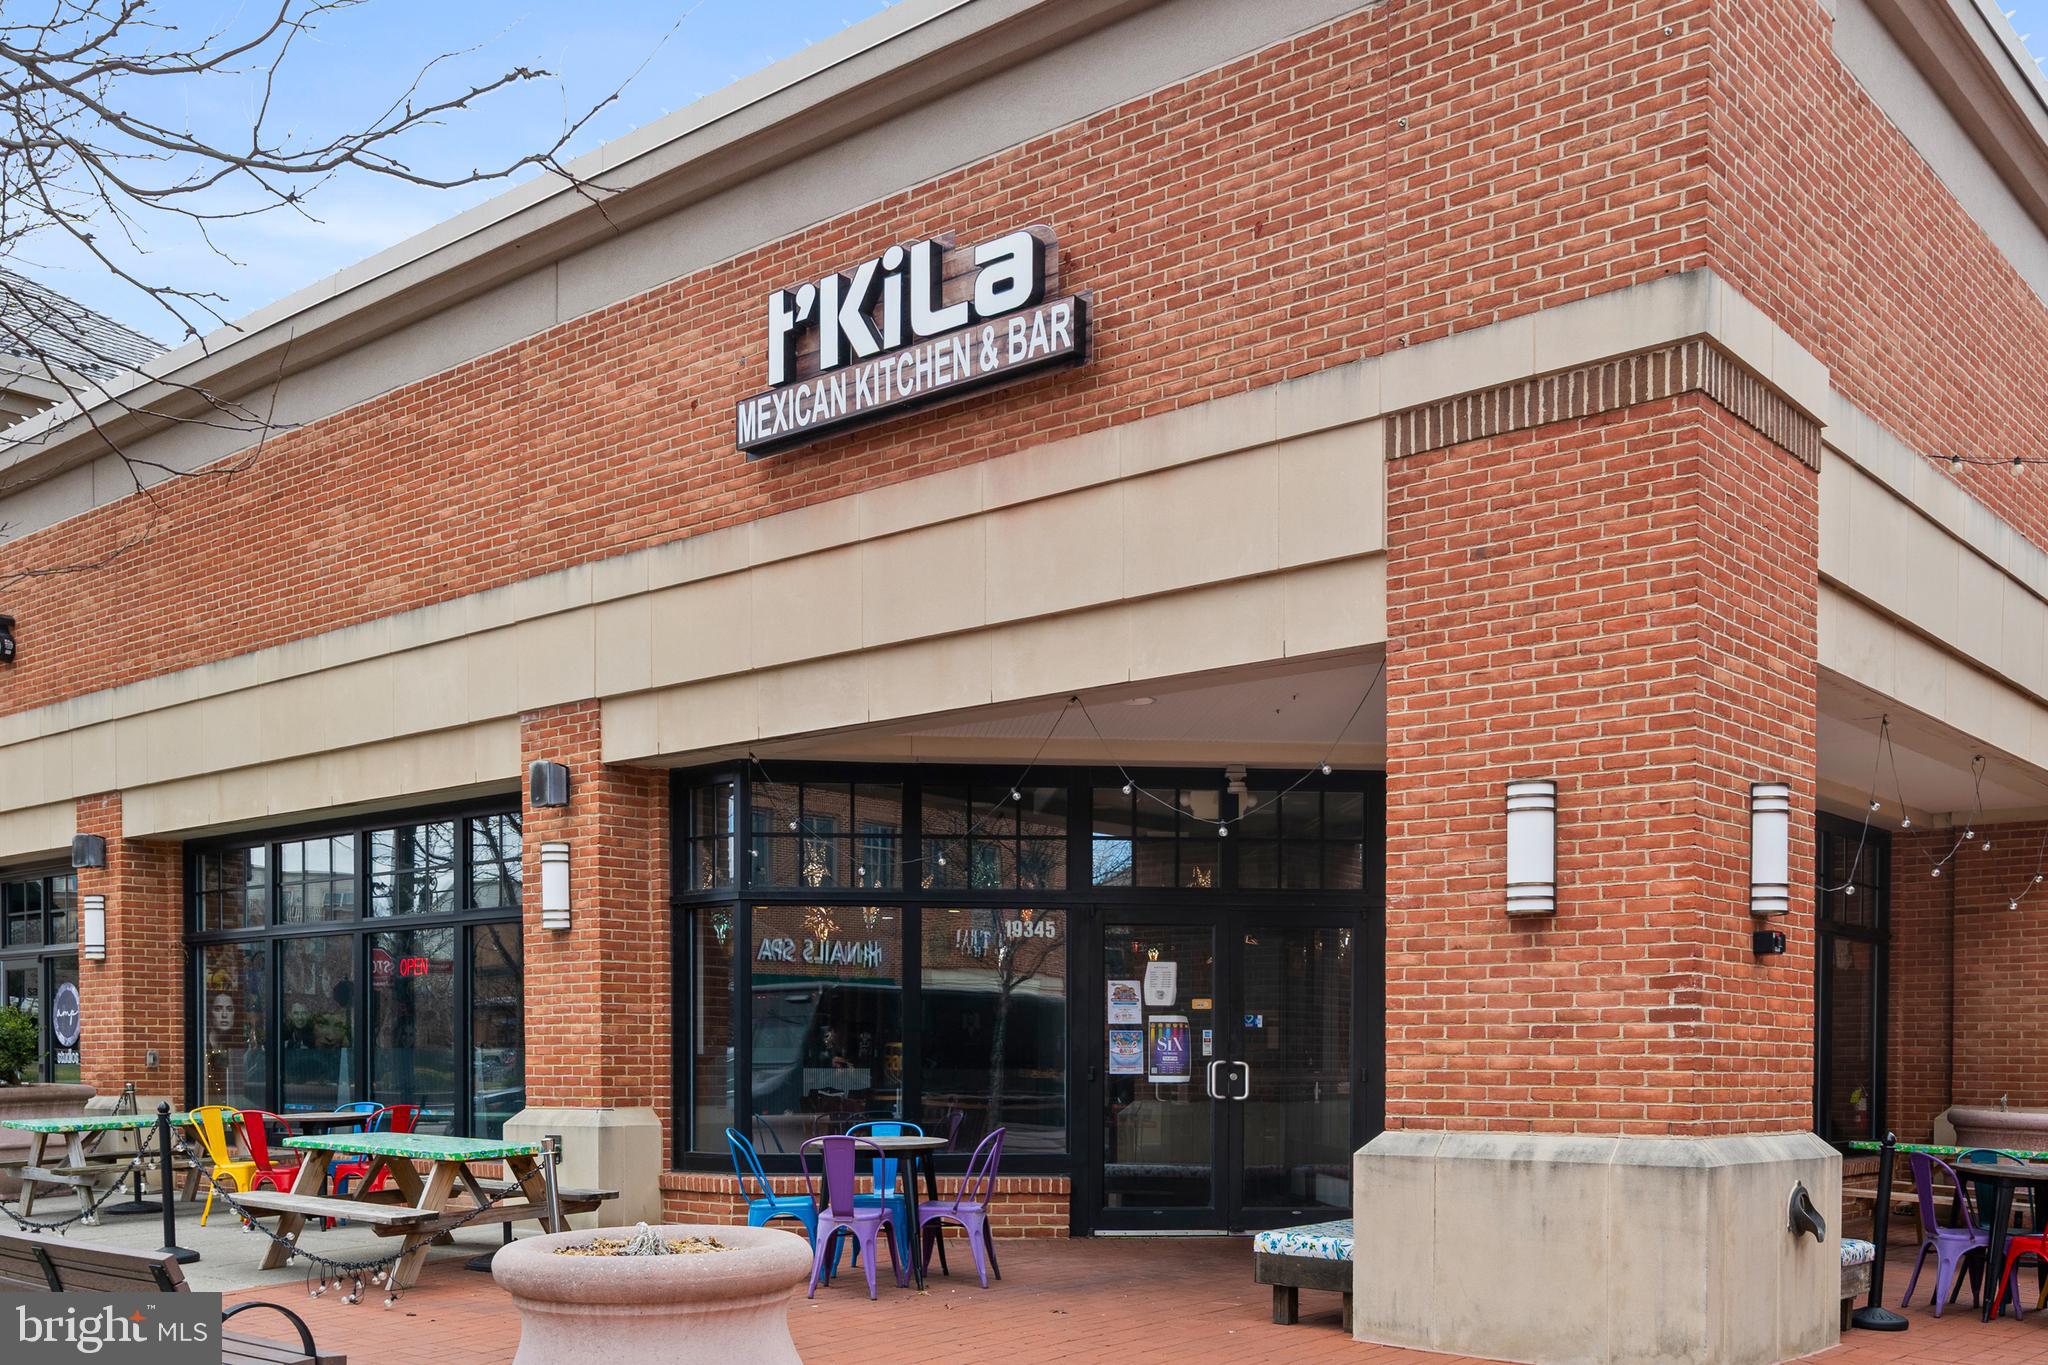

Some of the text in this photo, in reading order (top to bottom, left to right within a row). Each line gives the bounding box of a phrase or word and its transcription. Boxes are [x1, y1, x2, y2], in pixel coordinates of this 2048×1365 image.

[738, 303, 1072, 444] MEXICAN KITCHEN & BAR
[1004, 920, 1056, 938] 19345
[399, 957, 429, 977] OPEN
